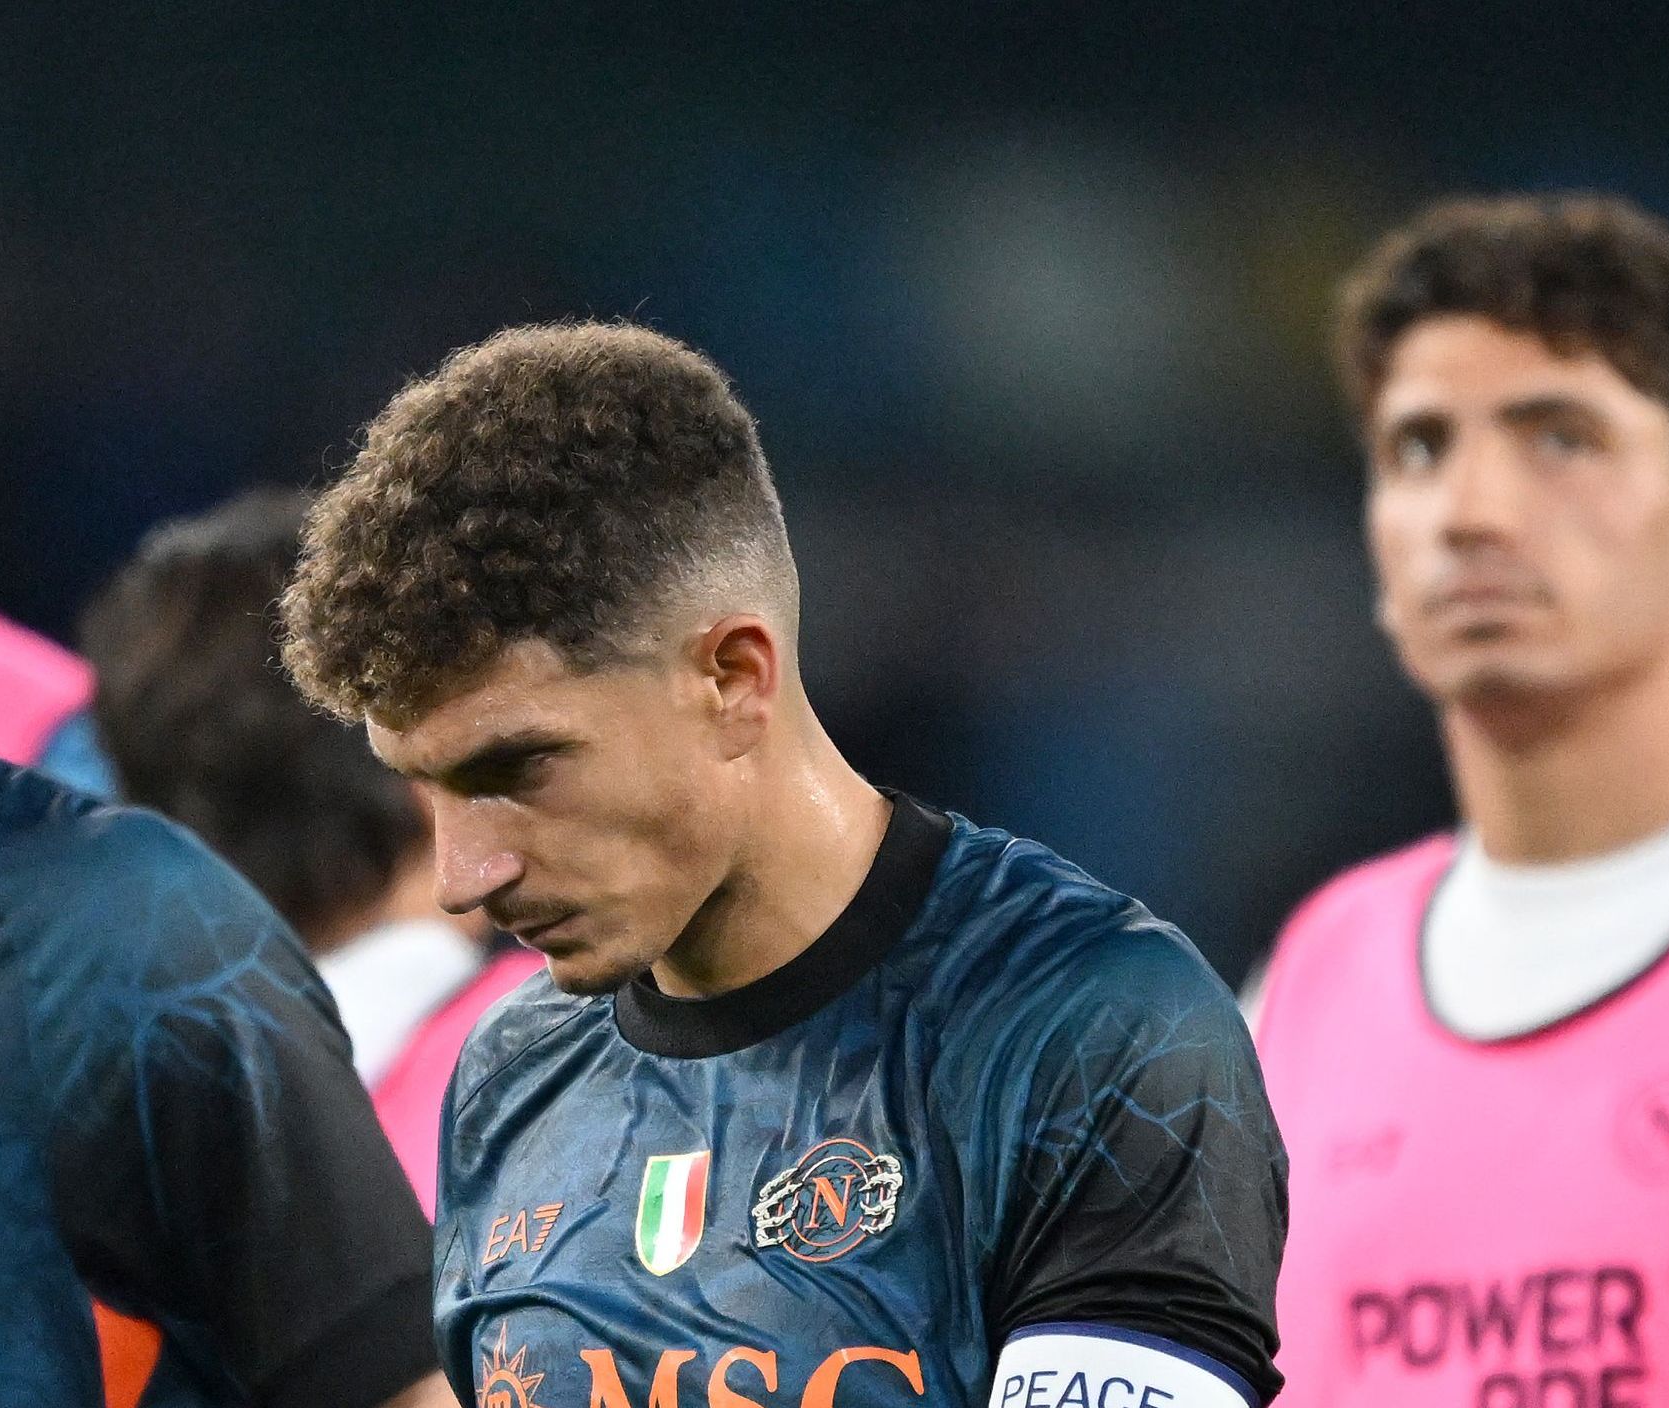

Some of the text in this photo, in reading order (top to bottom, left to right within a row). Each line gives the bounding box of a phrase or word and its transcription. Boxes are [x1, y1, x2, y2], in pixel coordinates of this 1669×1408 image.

[807, 1172, 856, 1231] N
[482, 1202, 565, 1266] EA7
[1348, 1264, 1647, 1374] POWER
